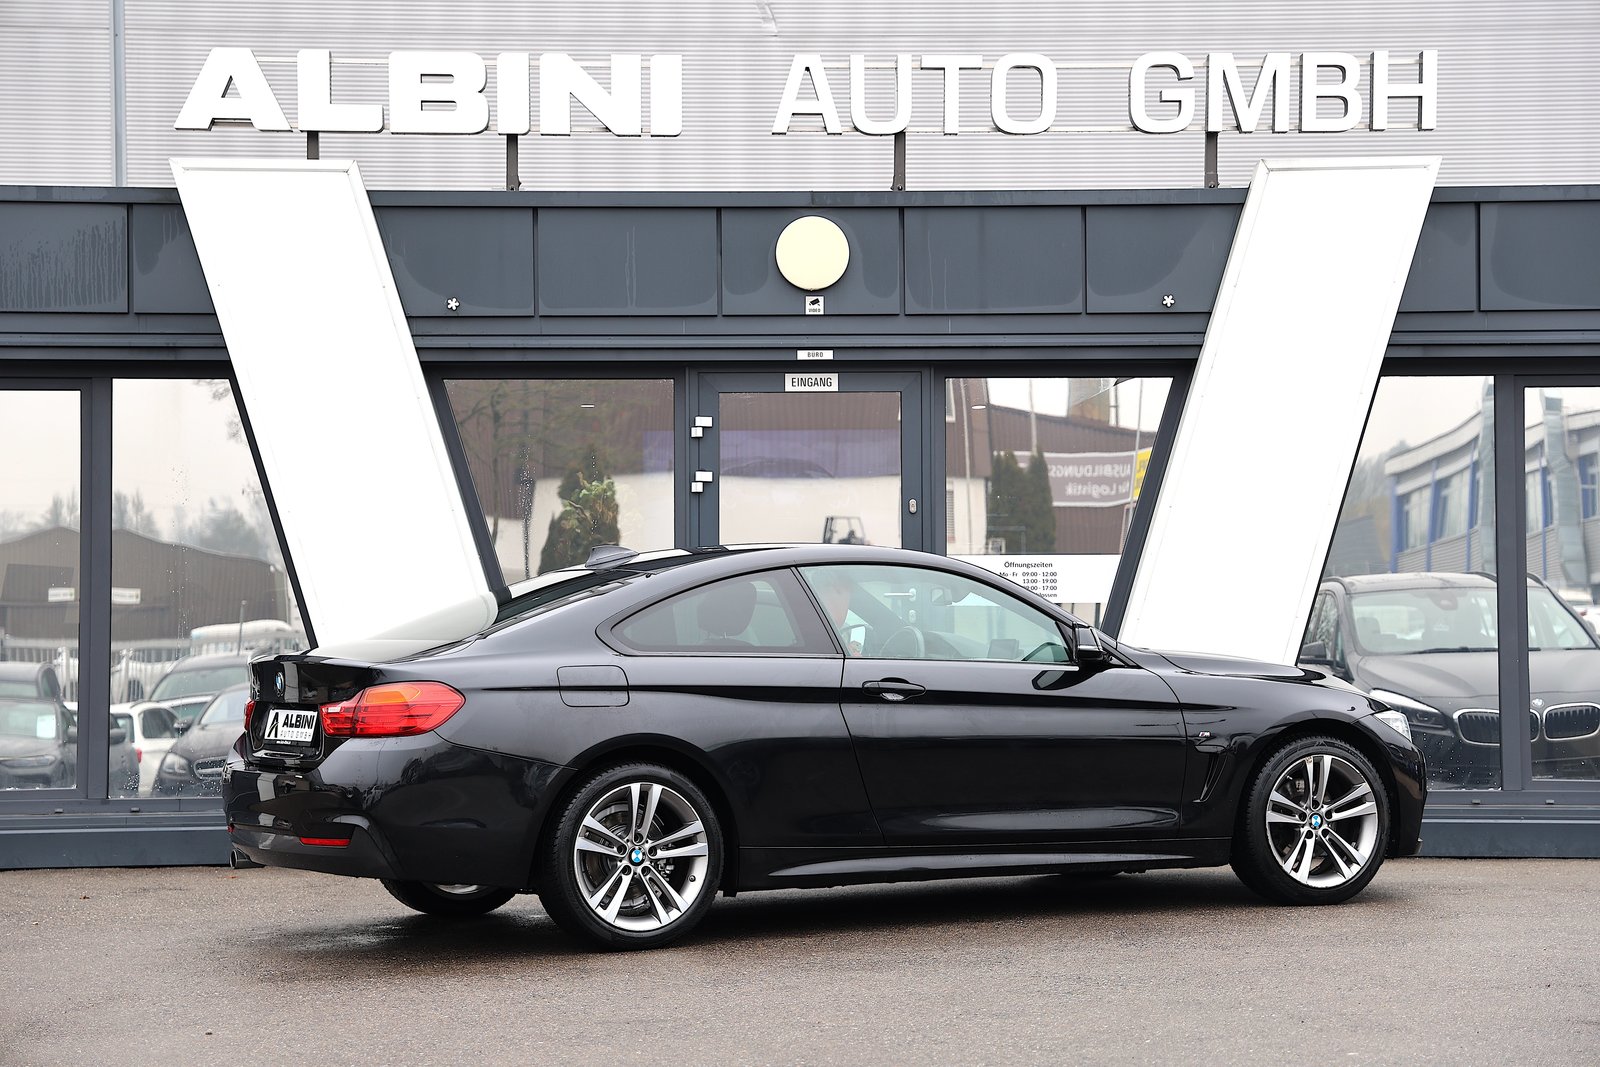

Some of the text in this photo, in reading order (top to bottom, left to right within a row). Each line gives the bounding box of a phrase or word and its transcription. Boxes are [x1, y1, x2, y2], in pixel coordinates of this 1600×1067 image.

[174, 47, 1439, 137] ALBINI AUTO GMBH
[791, 377, 833, 387] EINGANG
[1004, 561, 1053, 569] Öffnungszeiten
[282, 713, 315, 729] ALBINI
